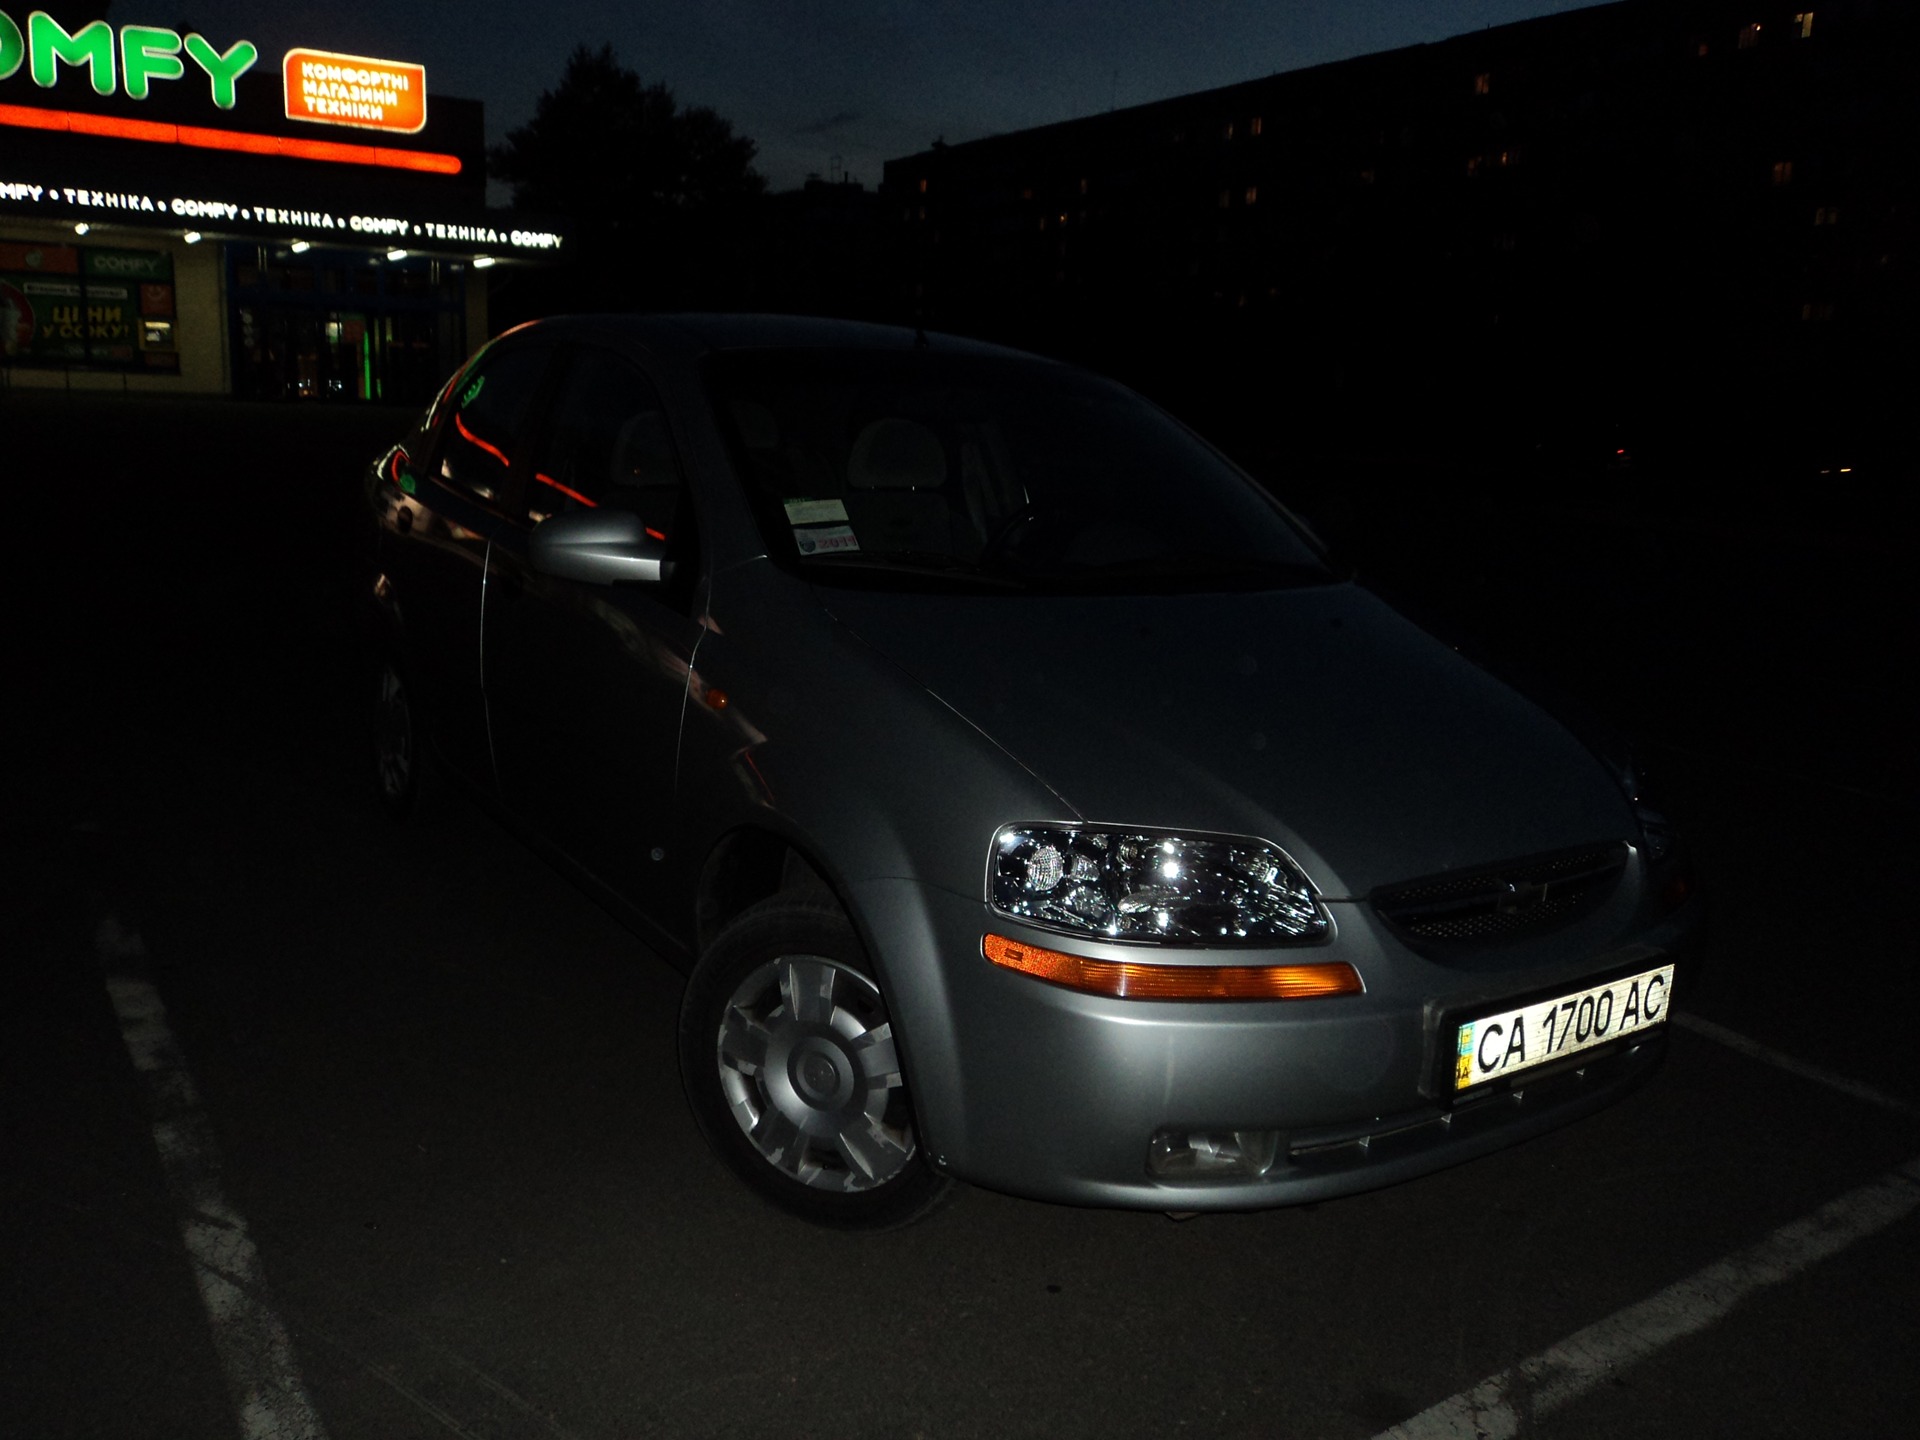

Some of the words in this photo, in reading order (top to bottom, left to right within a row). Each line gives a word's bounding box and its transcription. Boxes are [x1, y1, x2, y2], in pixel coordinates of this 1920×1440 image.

[0, 9, 258, 110] MFY
[302, 61, 409, 91] КОМФОРТНІ
[303, 79, 398, 106] МАГАЗИНИ
[304, 96, 384, 121] ТЕХНІКИ
[64, 188, 154, 212] ТЕХНІКА
[172, 198, 238, 220] COMFY
[254, 207, 333, 228] ТЕХНІКА
[350, 215, 408, 235] COMFY
[425, 222, 498, 242] ТЕХНІКА
[511, 230, 562, 248] COMFY
[93, 256, 158, 271] COMFY
[1478, 1014, 1525, 1073] CA
[1543, 990, 1613, 1054] 1700
[1619, 975, 1664, 1031] AC
